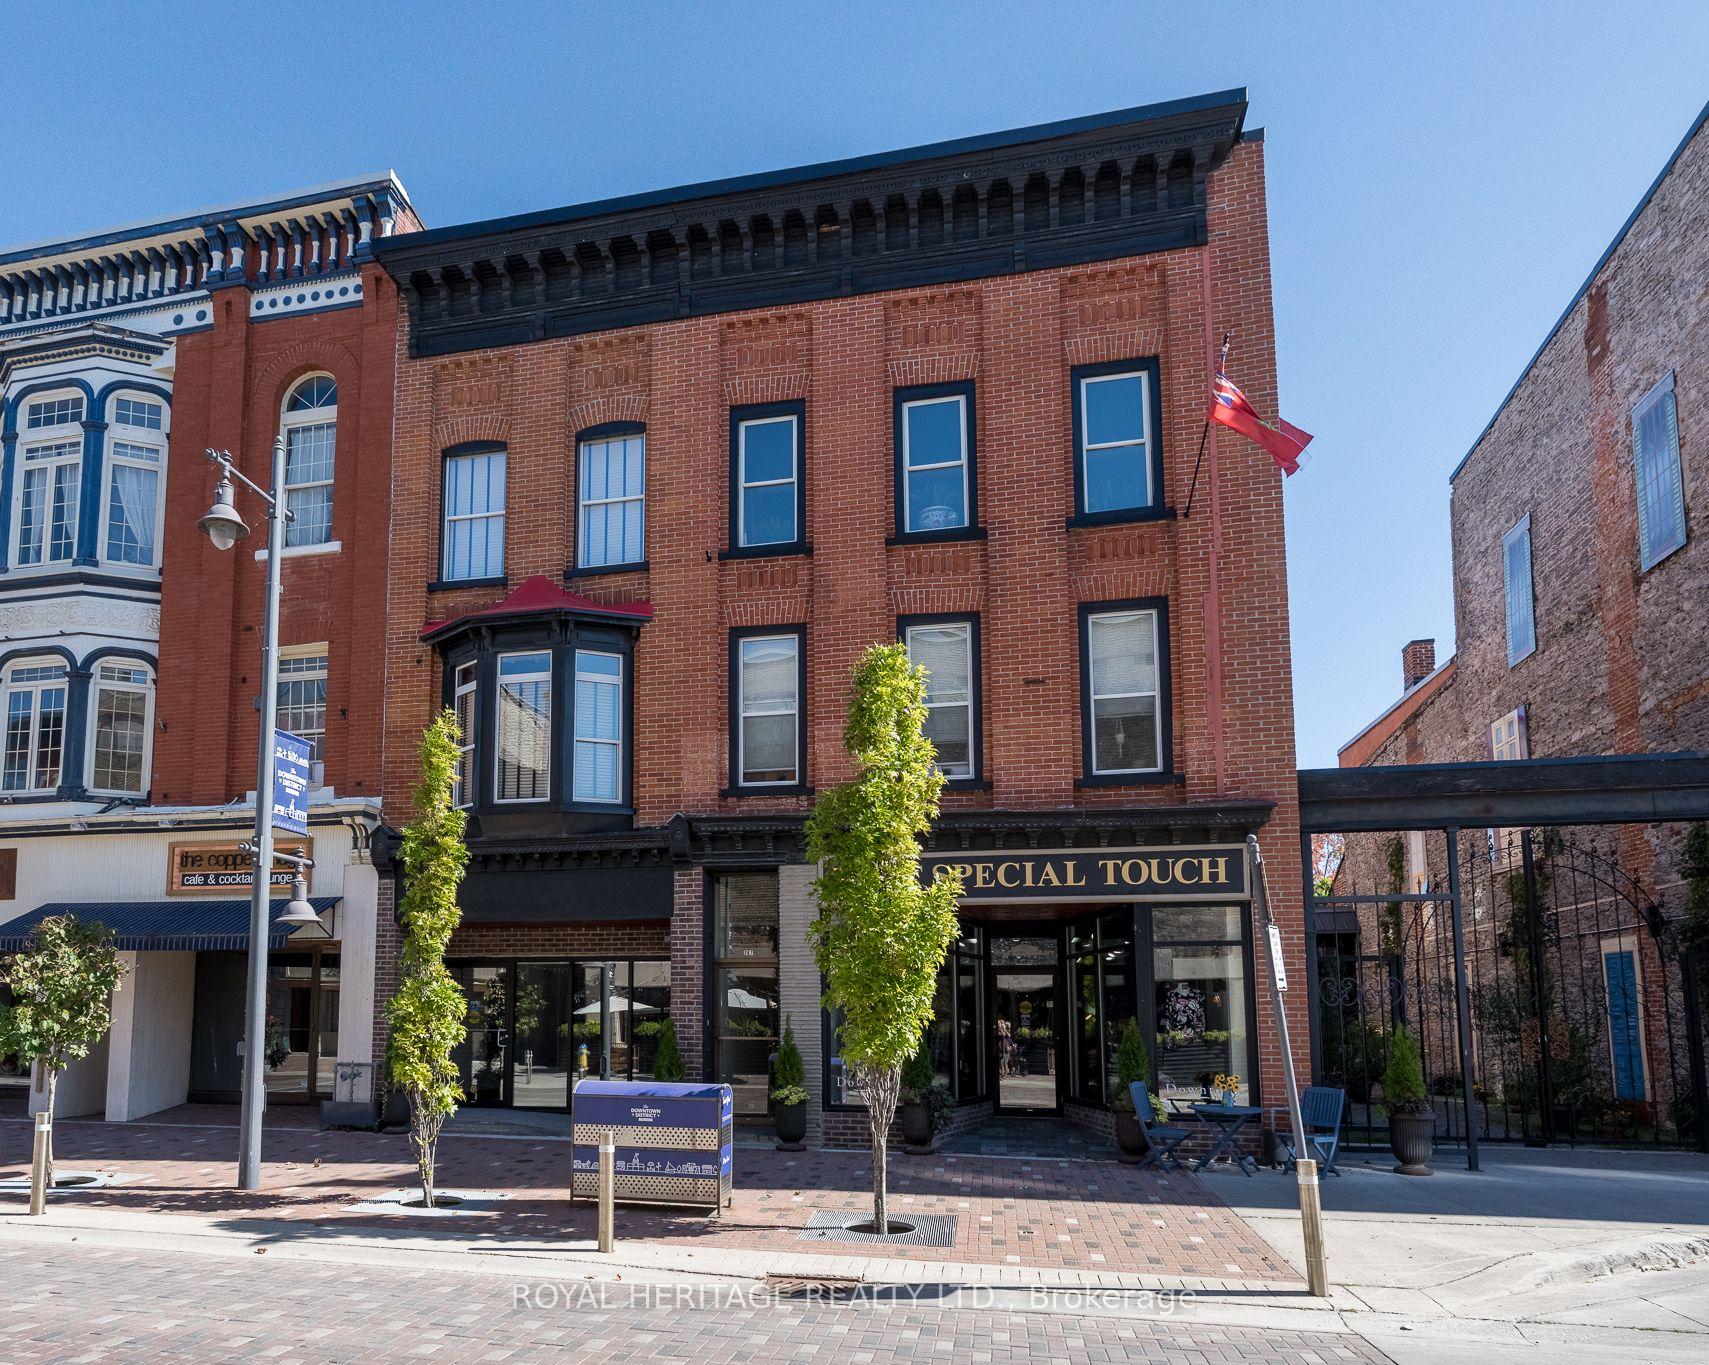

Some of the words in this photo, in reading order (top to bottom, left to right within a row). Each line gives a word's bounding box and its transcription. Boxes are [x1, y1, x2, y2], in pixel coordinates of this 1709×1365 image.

[278, 769, 306, 786] DOWNTOWN
[180, 851, 202, 868] the
[208, 853, 253, 870] coppe
[184, 873, 204, 885] cafe
[207, 874, 216, 885] &
[270, 874, 293, 885] unge
[1098, 857, 1229, 885] TOUCH
